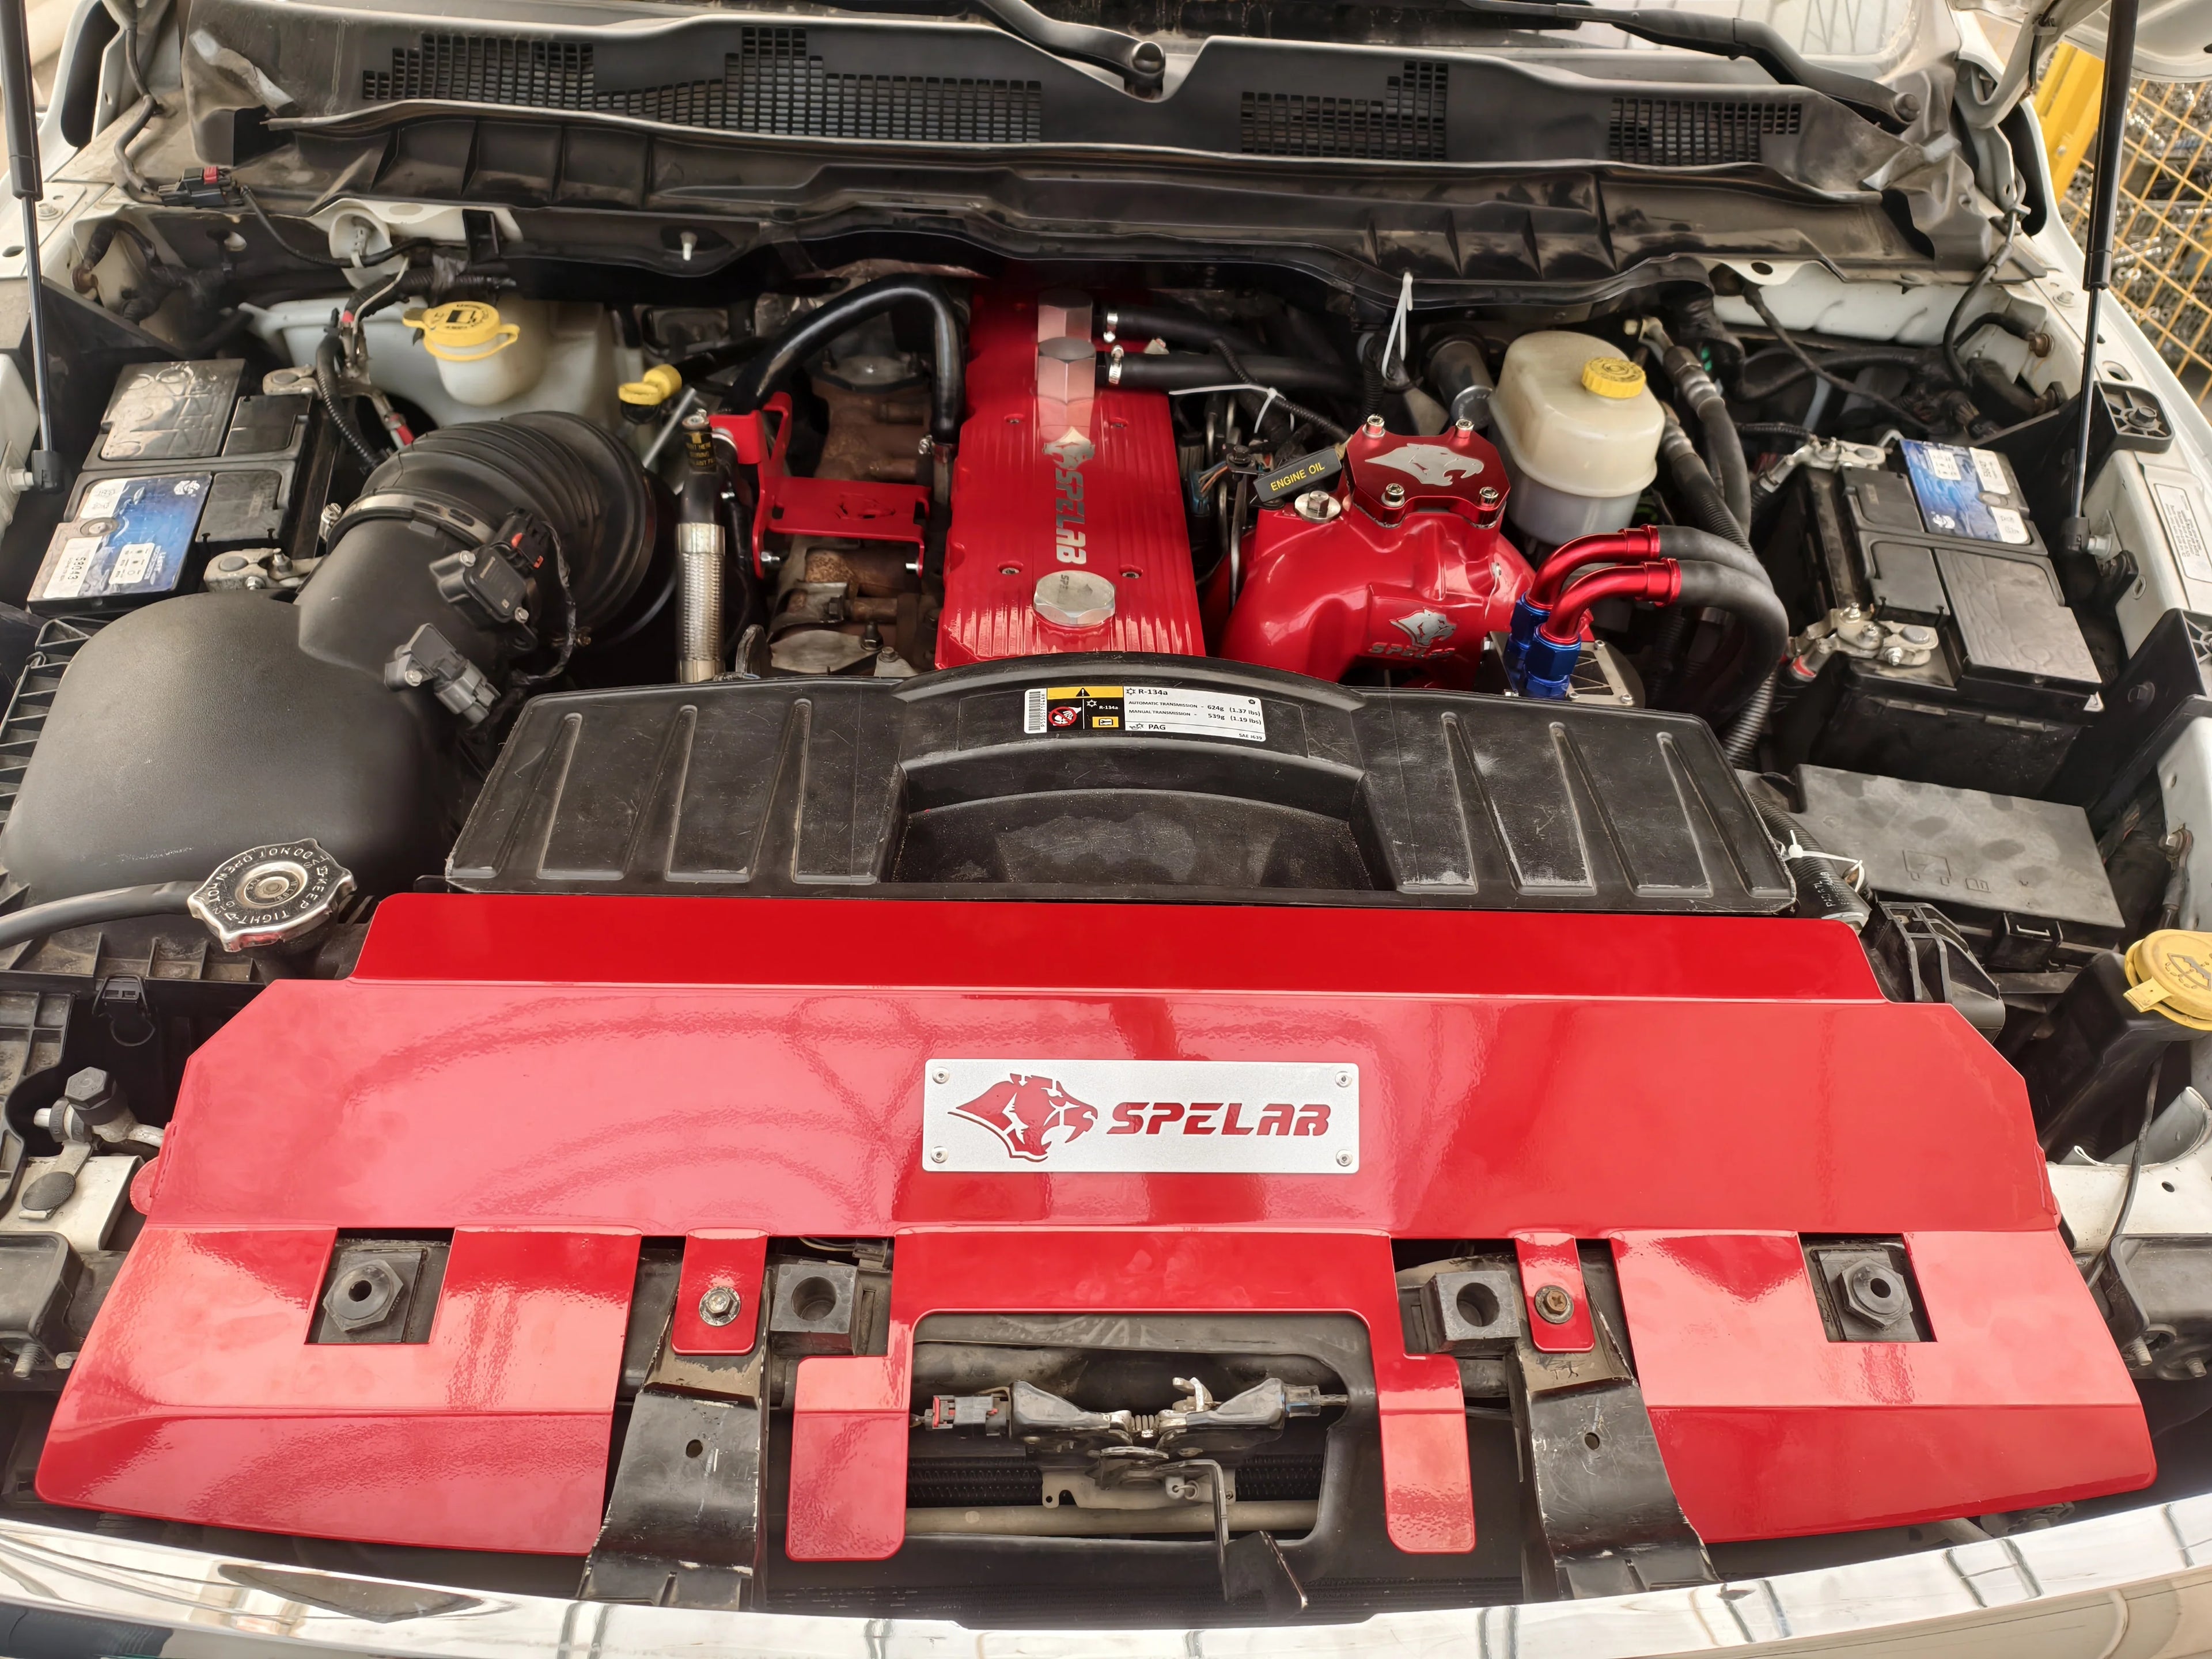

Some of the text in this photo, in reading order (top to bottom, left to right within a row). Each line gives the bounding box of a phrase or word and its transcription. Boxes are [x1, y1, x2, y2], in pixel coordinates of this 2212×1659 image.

[1270, 462, 1325, 491] ENGINE OIL
[1055, 468, 1087, 565] SPELAB
[215, 854, 253, 881] OPEN
[302, 854, 330, 869] TVS
[207, 881, 222, 903] HOT
[299, 878, 328, 910] KEEP
[237, 909, 291, 925] TIGHT
[1106, 1101, 1331, 1137] SPELAB
